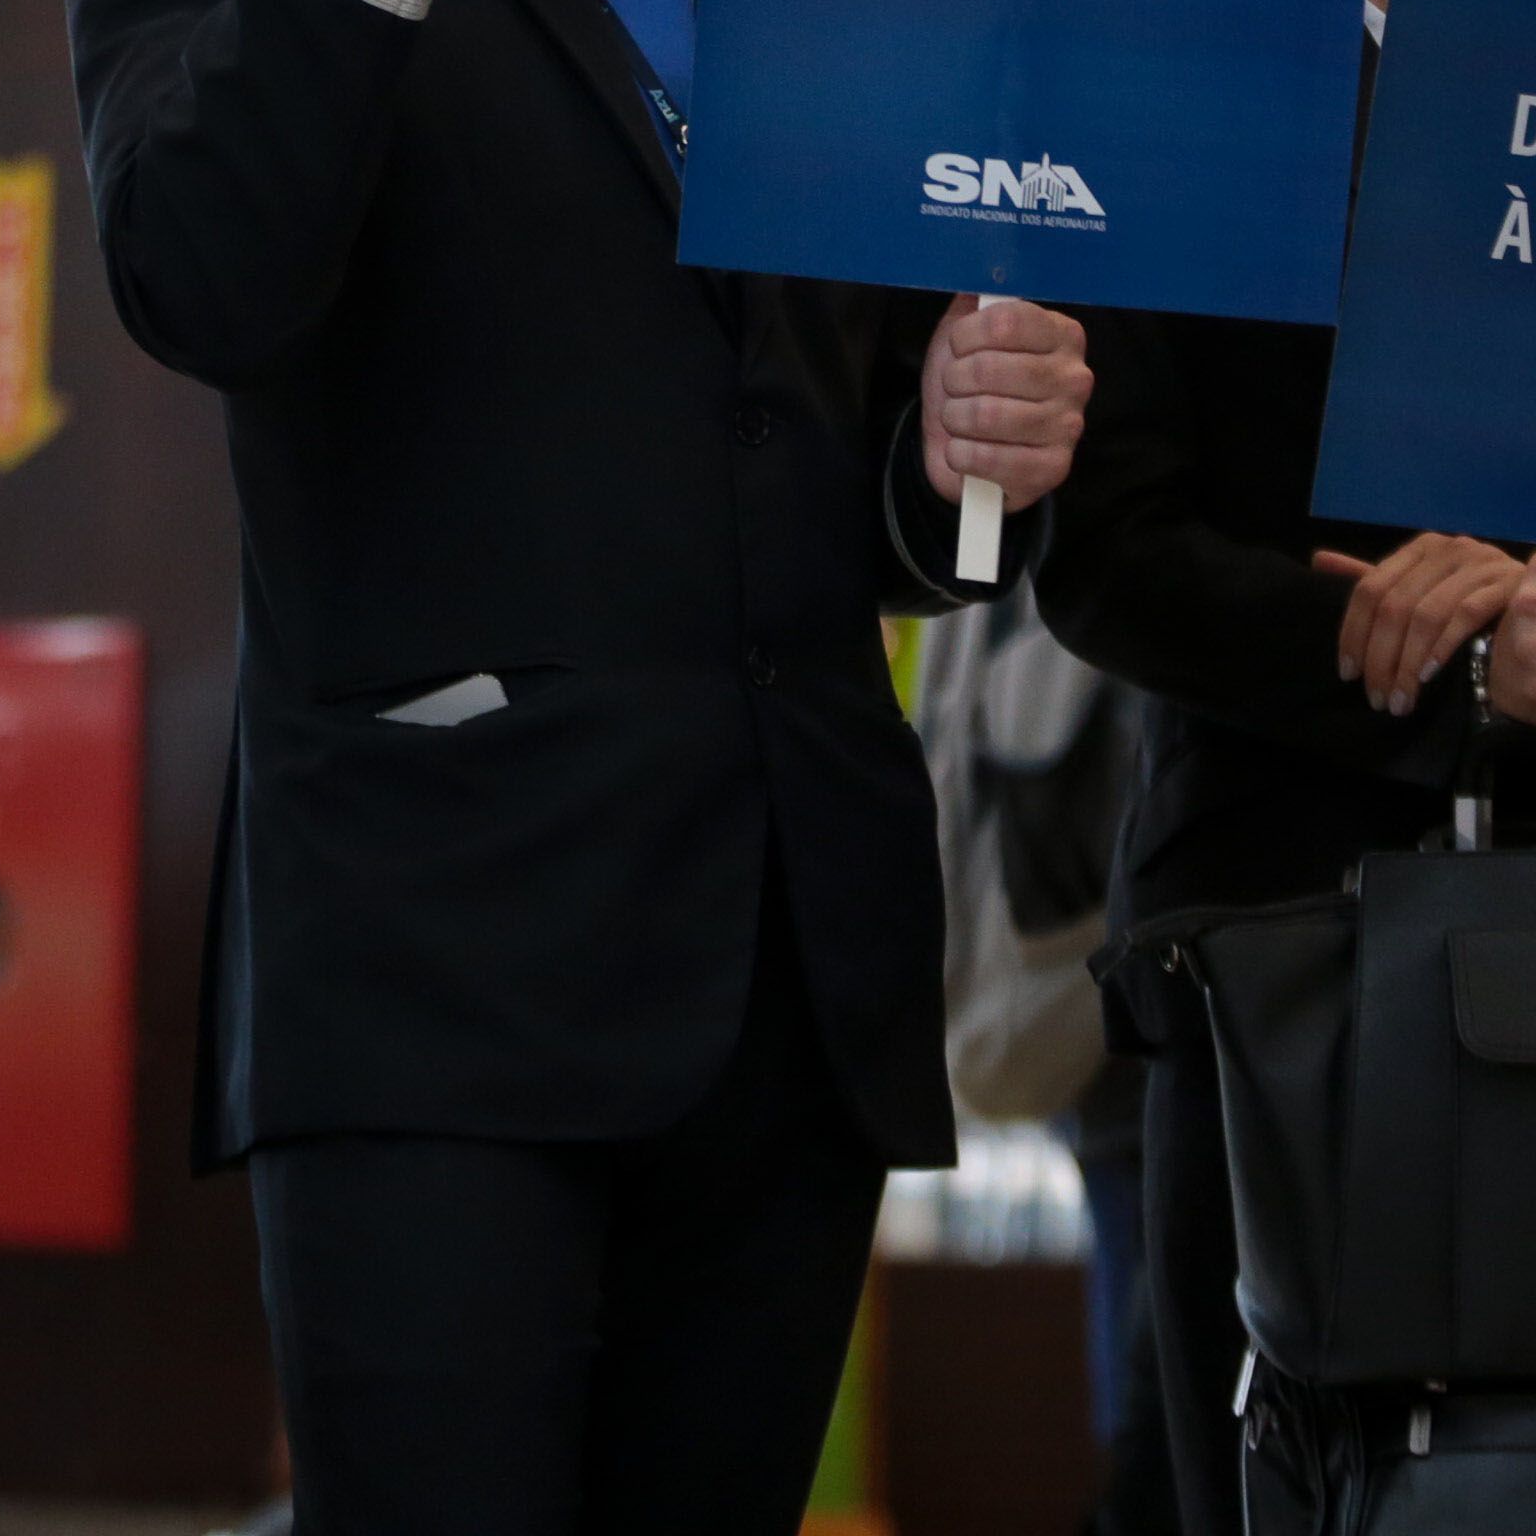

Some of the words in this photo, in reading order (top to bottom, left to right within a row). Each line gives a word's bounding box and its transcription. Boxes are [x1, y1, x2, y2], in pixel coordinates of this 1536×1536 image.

[648, 89, 680, 124] Azul
[922, 152, 1107, 217] SNA
[920, 203, 971, 218] SINDICATO
[972, 209, 1019, 225] NACIONAL
[1021, 214, 1041, 226] DOS
[1043, 216, 1107, 232] AERONAUTAS
[1491, 184, 1532, 264] À
